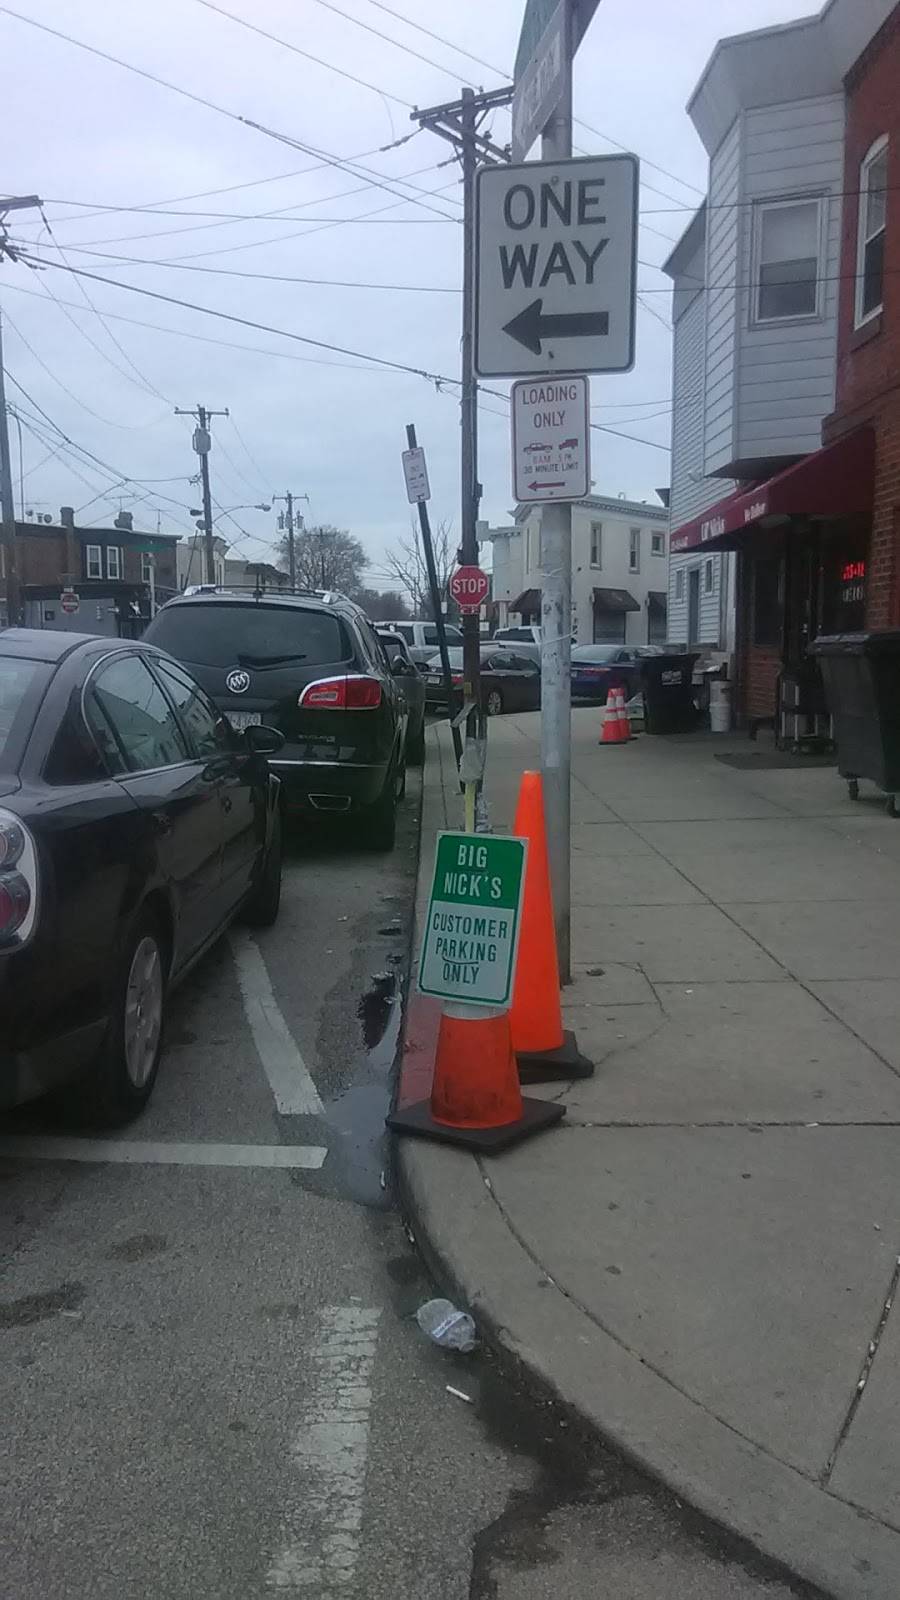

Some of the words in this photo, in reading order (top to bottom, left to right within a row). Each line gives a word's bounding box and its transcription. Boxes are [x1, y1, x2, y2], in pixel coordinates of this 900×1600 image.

[504, 178, 606, 230] ONE
[499, 238, 610, 289] WAY
[522, 385, 577, 405] LOADING
[533, 410, 566, 428] ONLY
[523, 465, 533, 474] 30
[535, 463, 559, 473] MINUTE
[561, 461, 579, 472] LIMIT
[453, 578, 486, 594] STOP
[457, 844, 488, 868] BIG
[443, 872, 501, 899] NICK'S
[432, 912, 508, 939] CUSTOMER
[435, 937, 497, 962] PARKING
[442, 963, 480, 985] ONLY
